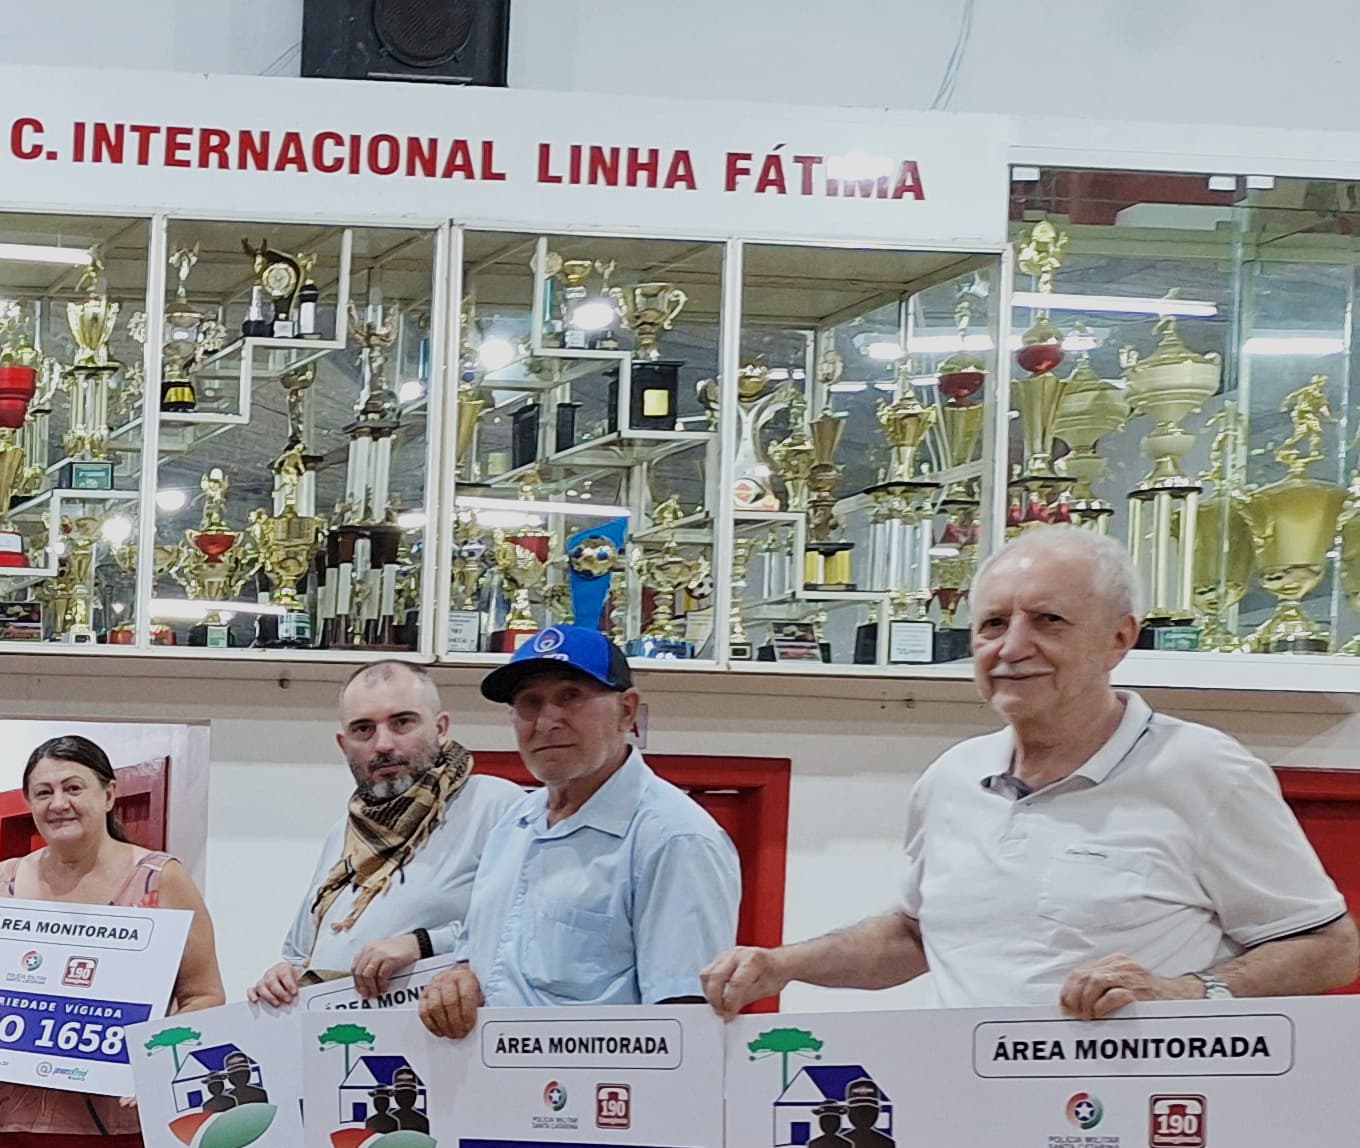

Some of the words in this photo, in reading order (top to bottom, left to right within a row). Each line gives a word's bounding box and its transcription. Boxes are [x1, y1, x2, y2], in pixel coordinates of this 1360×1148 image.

[73, 122, 506, 180] INTERNACIONAL
[538, 143, 696, 190] LINHA
[36, 922, 138, 940] MONITORADA
[68, 965, 91, 978] 190
[66, 1004, 121, 1018] VIGIADA
[35, 1020, 125, 1055] 1658
[496, 1034, 543, 1053] ÁREA
[549, 1037, 668, 1054] MONITORADA
[993, 1036, 1065, 1060] ÁREA
[1076, 1036, 1270, 1059] MONITORADA
[599, 1100, 625, 1116] 190
[1157, 1114, 1198, 1135] 190
